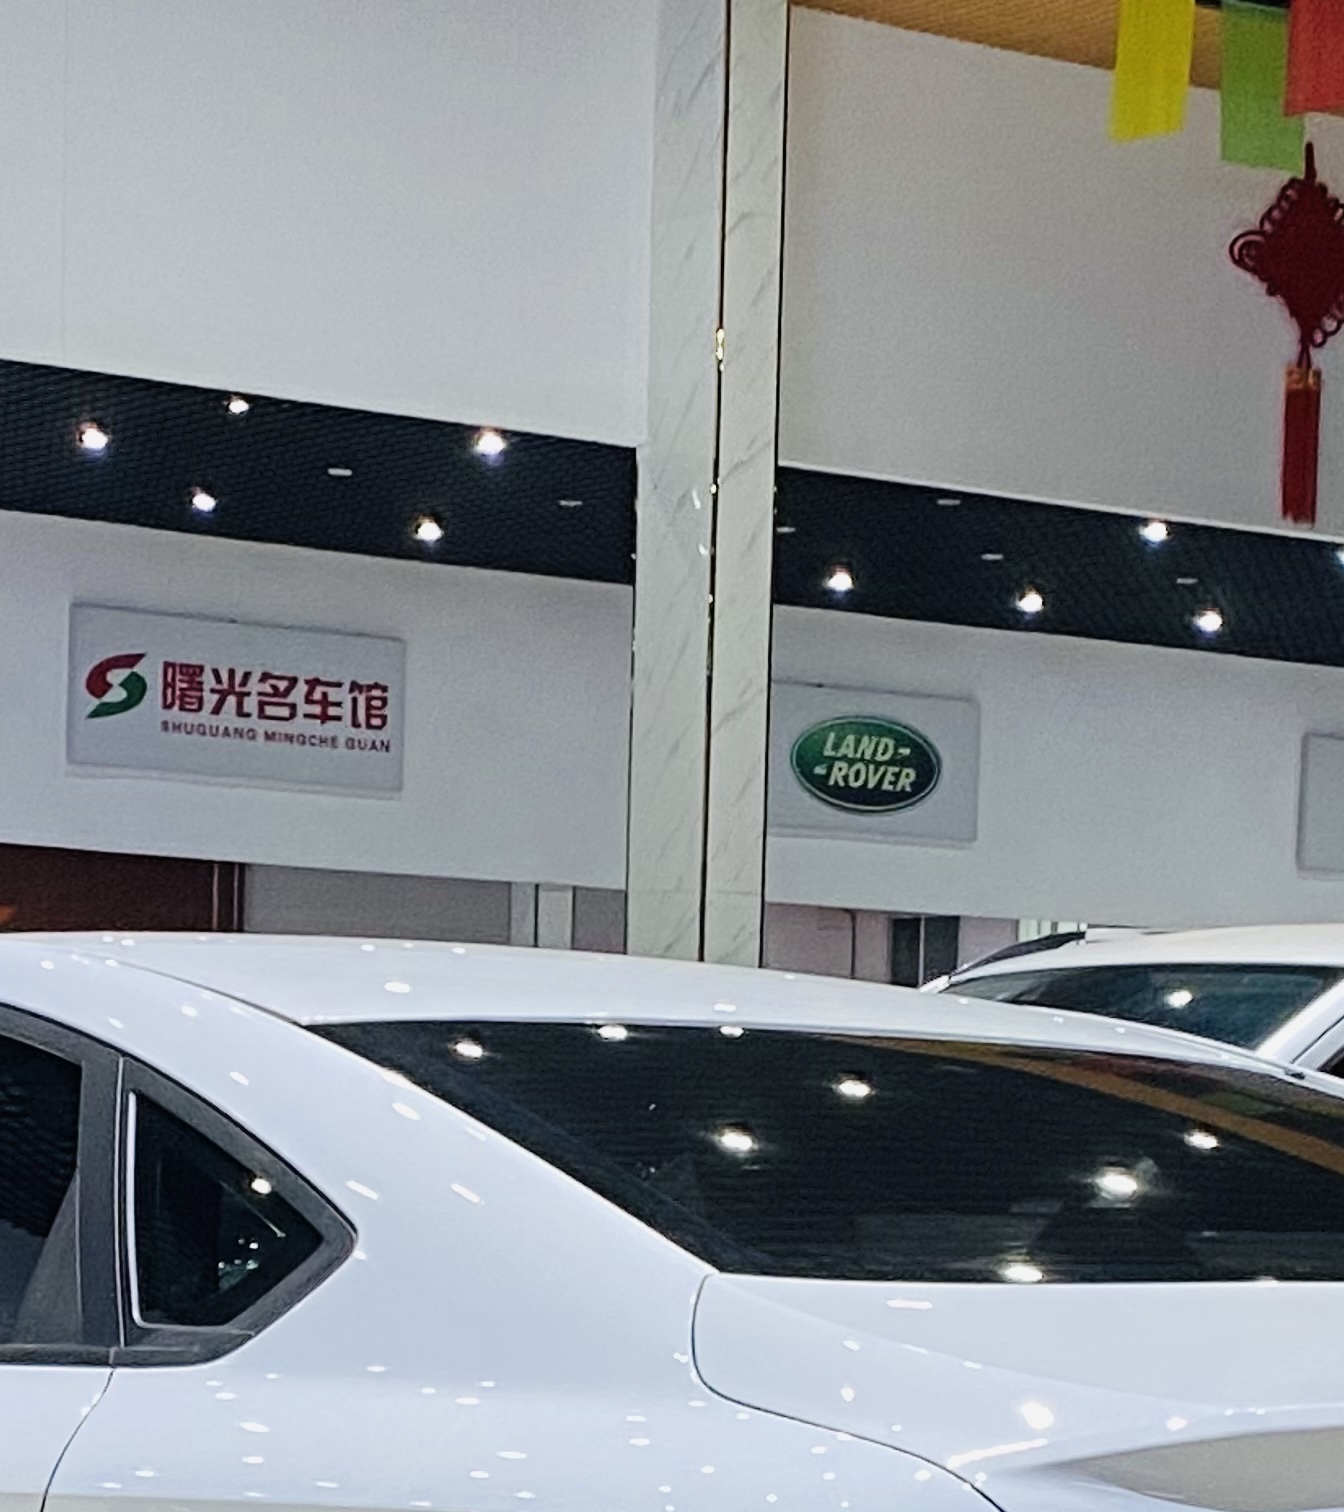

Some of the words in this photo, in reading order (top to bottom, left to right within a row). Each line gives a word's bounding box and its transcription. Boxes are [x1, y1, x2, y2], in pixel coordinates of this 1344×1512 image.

[161, 660, 390, 731] 曙光名车馆
[160, 720, 257, 741] SHUGUANG
[263, 730, 338, 749] MINGCHE
[345, 738, 391, 753] GUAN
[823, 732, 896, 762] LAND
[828, 760, 917, 792] ROVER
